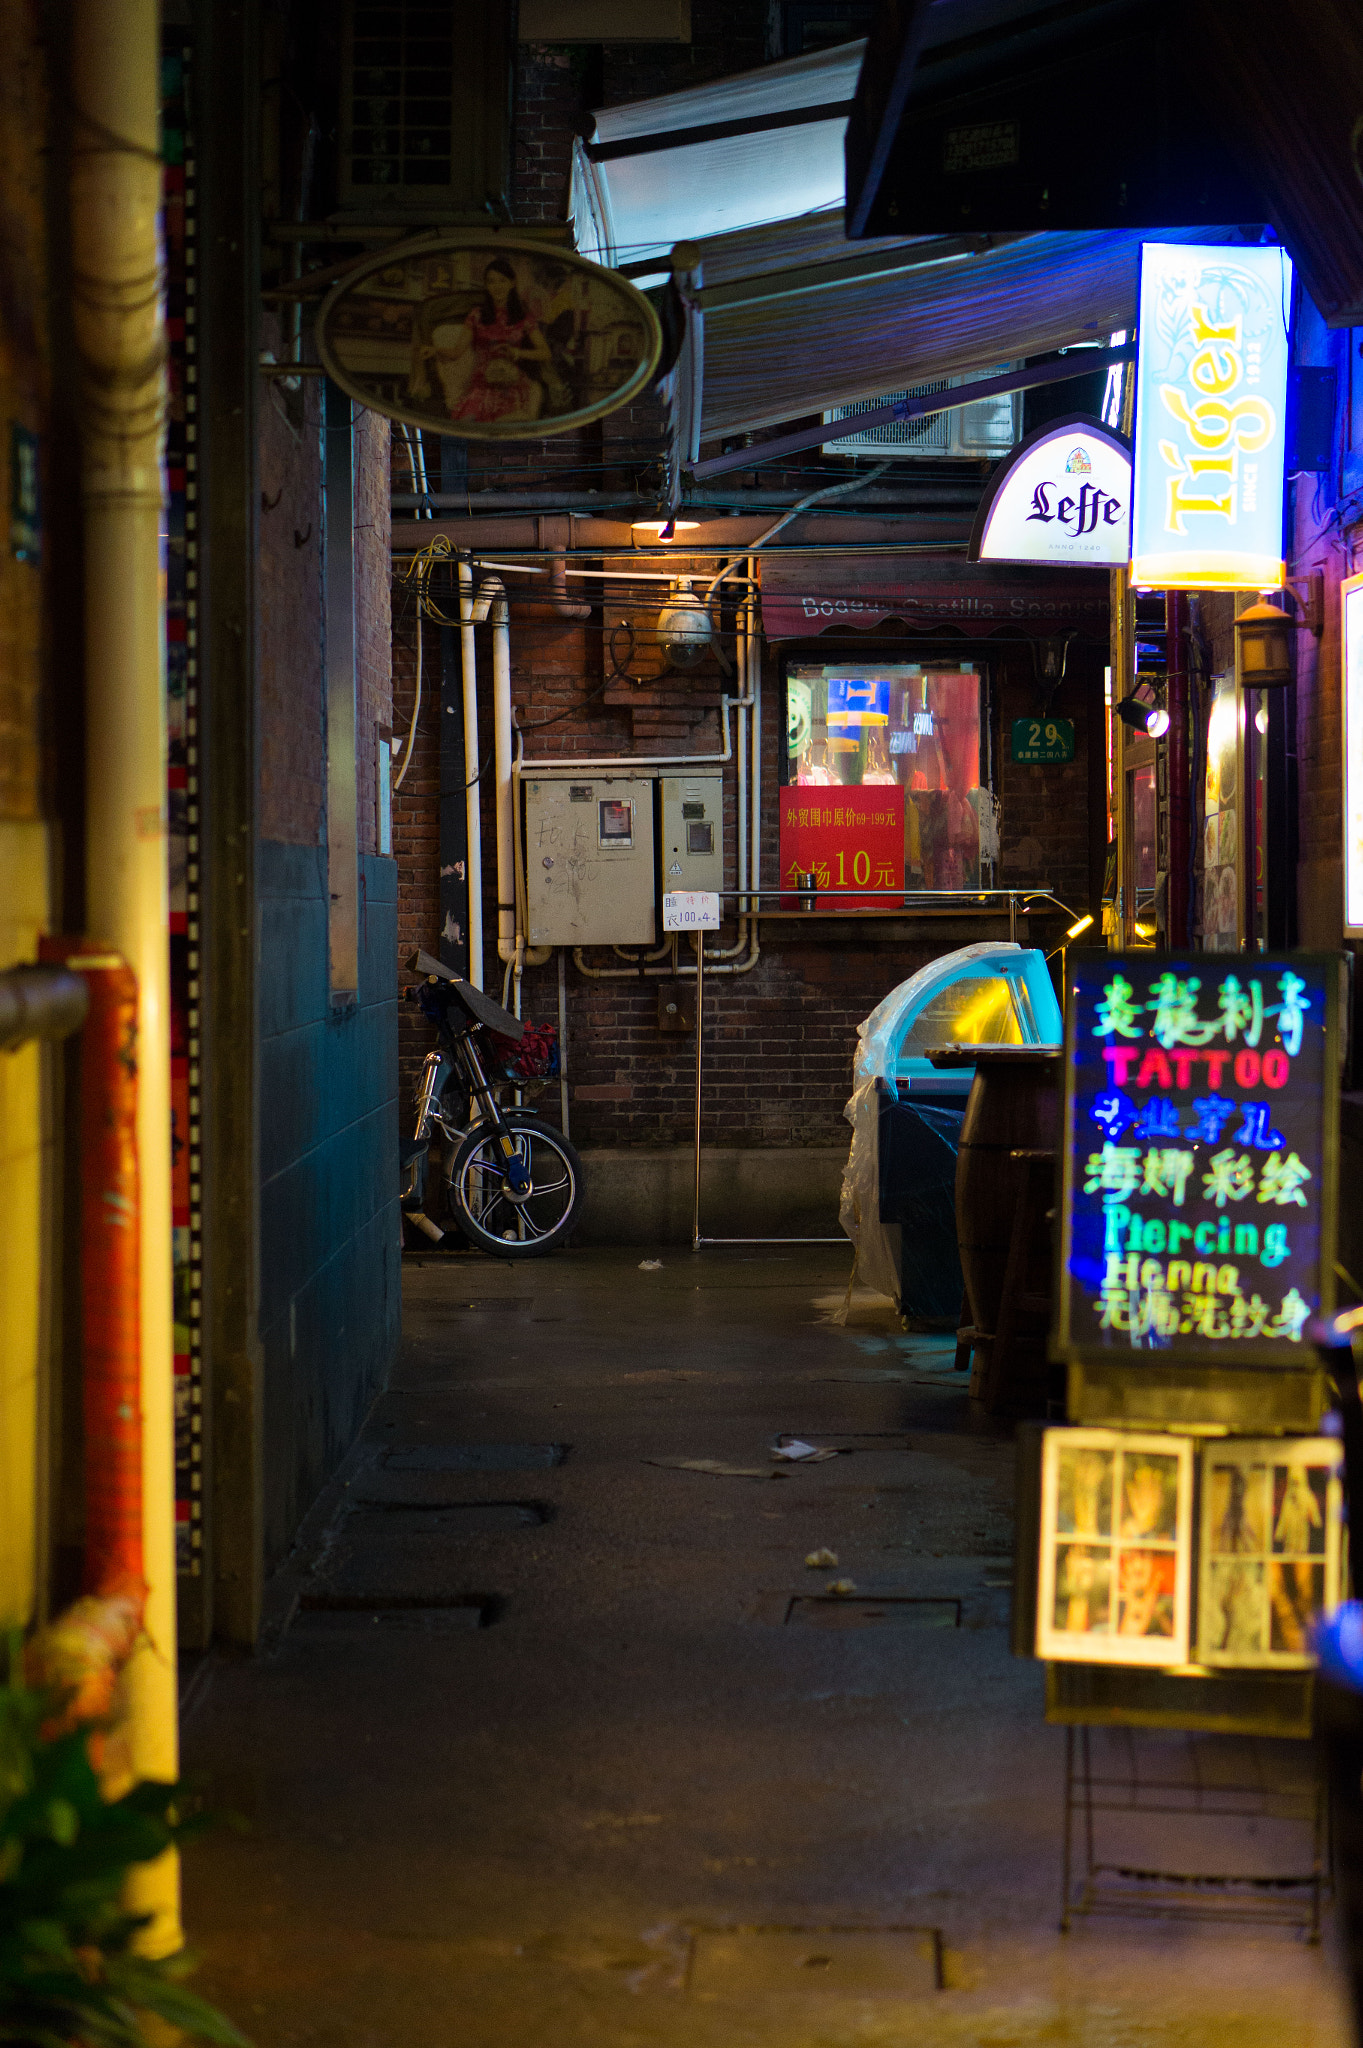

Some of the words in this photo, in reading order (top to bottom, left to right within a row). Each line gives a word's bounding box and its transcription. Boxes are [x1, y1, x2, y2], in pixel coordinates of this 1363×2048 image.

[1246, 342, 1262, 386] 1932
[1158, 303, 1276, 537] Tiger
[1025, 481, 1125, 537] Leffe
[1242, 463, 1258, 512] SINCE
[902, 598, 994, 617] Castilla
[1028, 723, 1058, 747] 29
[786, 807, 897, 828] 外贸围巾原价69-199元
[1102, 1045, 1290, 1091] TATTOO
[1102, 1203, 1291, 1268] Piercing
[1101, 1252, 1243, 1295] Henna
